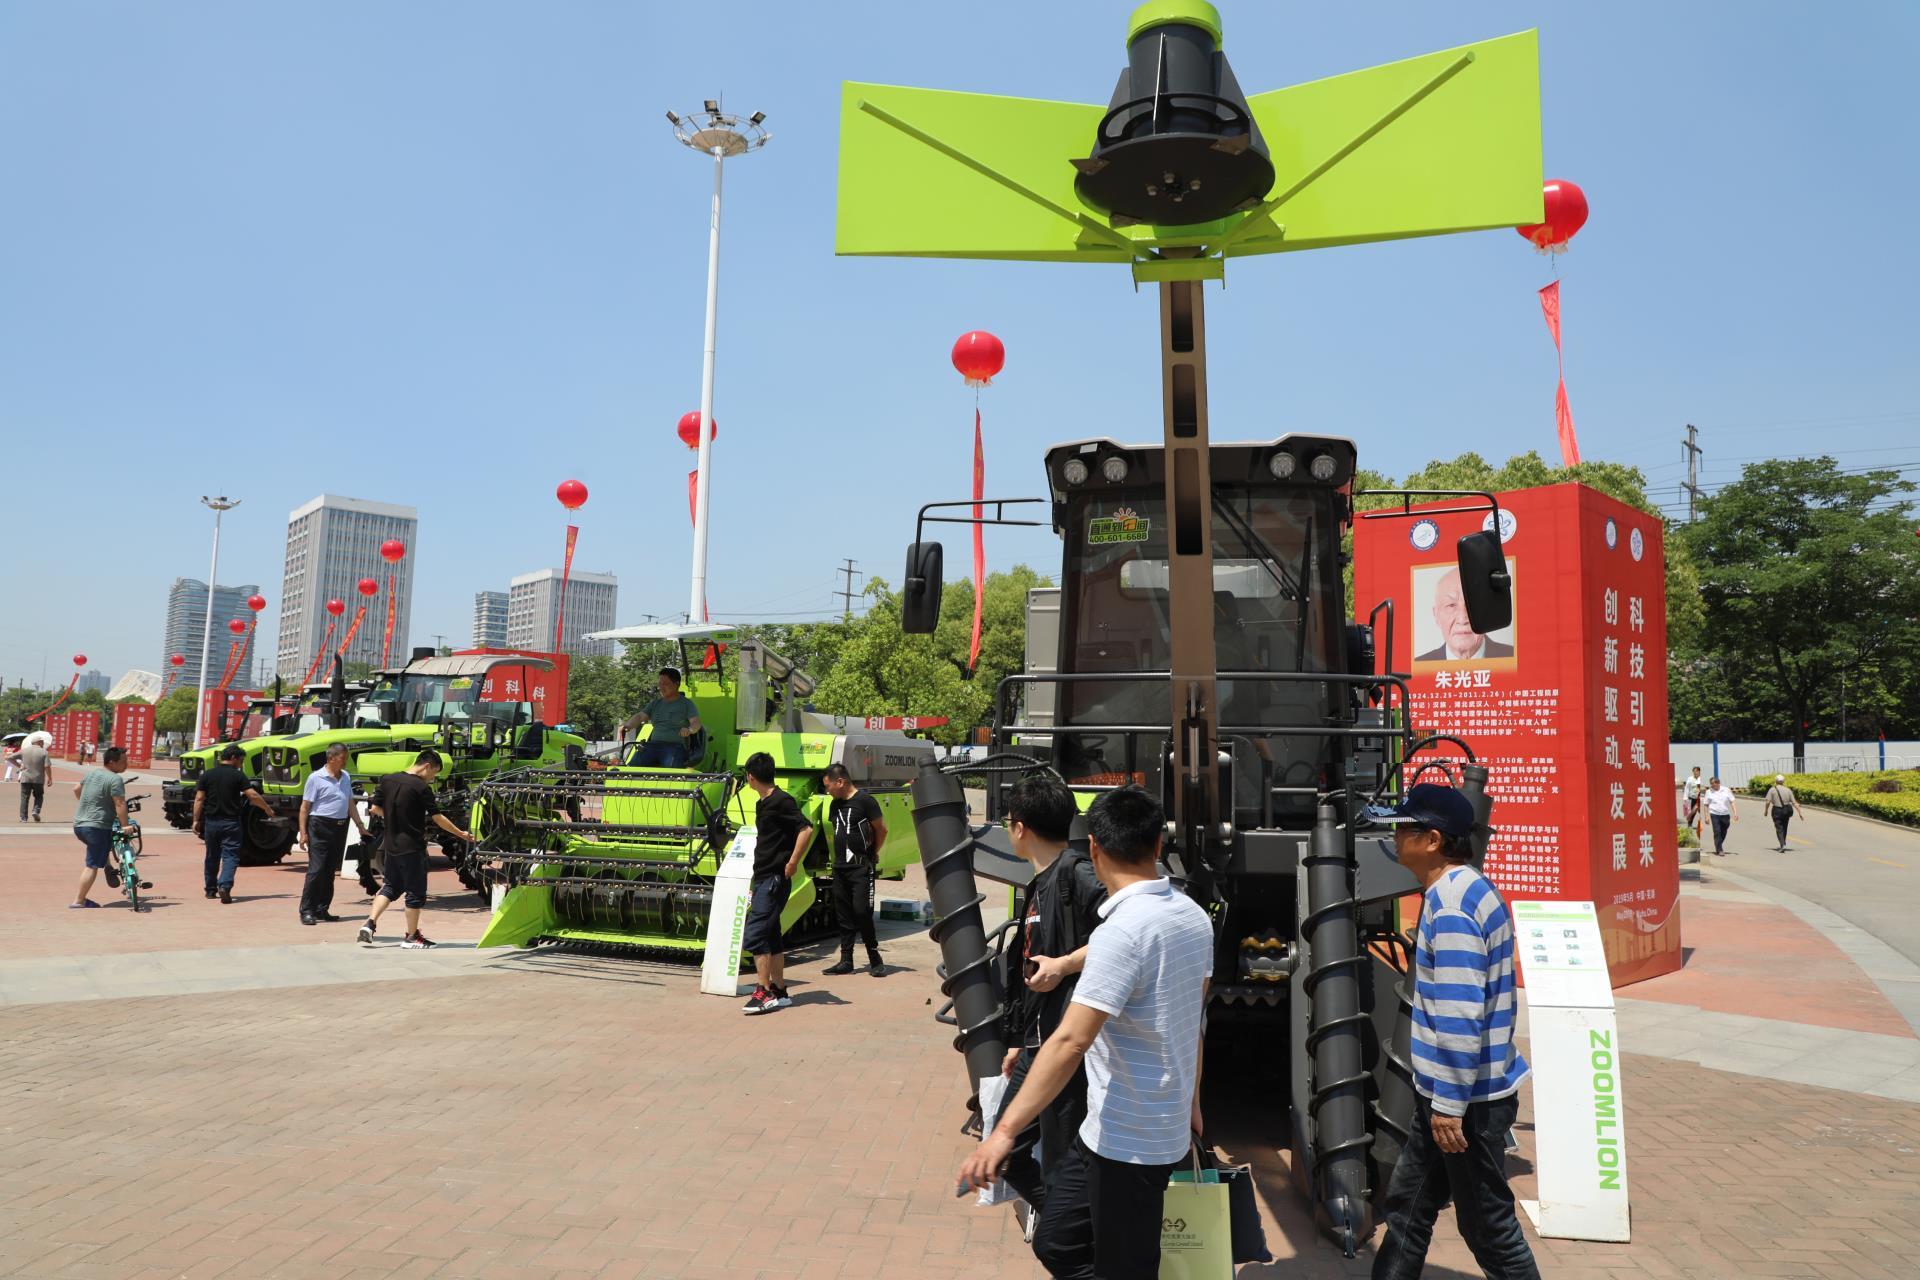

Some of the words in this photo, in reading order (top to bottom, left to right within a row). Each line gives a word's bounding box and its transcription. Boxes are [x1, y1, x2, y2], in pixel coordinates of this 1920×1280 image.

[1435, 669, 1492, 689] 朱光亚
[1604, 587, 1627, 872] 创新驱动发展
[1629, 596, 1654, 869] 科技引领未来
[885, 755, 916, 767] ZOOMLION
[727, 895, 746, 976] ZOOMLION
[1589, 1029, 1621, 1190] ZOOMLION
